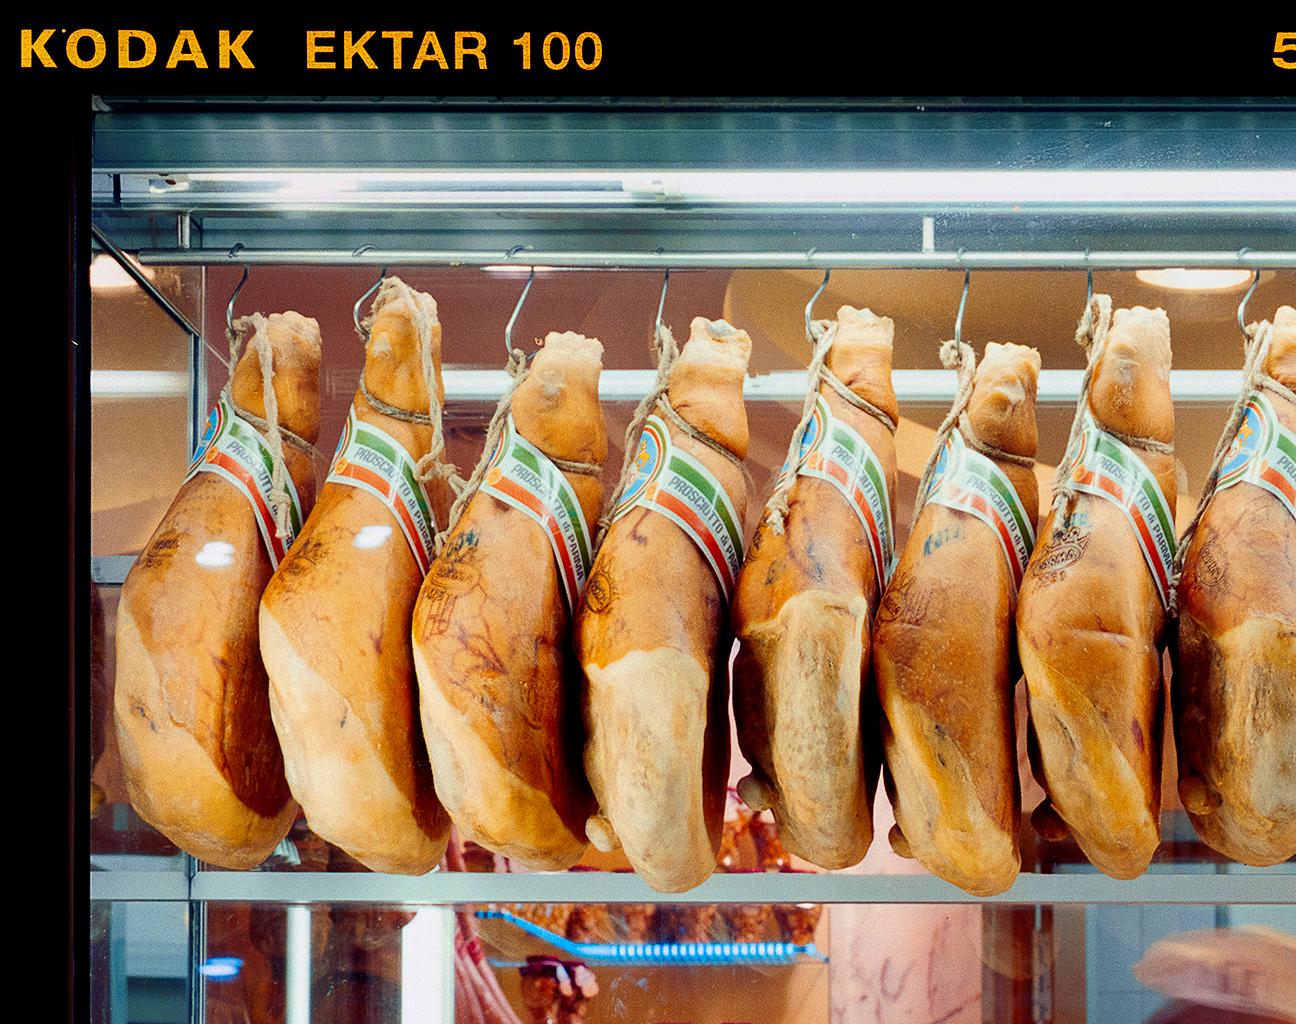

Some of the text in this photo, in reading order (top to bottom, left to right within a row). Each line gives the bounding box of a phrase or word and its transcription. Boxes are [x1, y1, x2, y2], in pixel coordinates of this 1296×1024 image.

[668, 475, 724, 535] PROSCIUTTO
[719, 533, 730, 547] di
[567, 533, 585, 581] PARMA
[1152, 523, 1174, 571] PARMA
